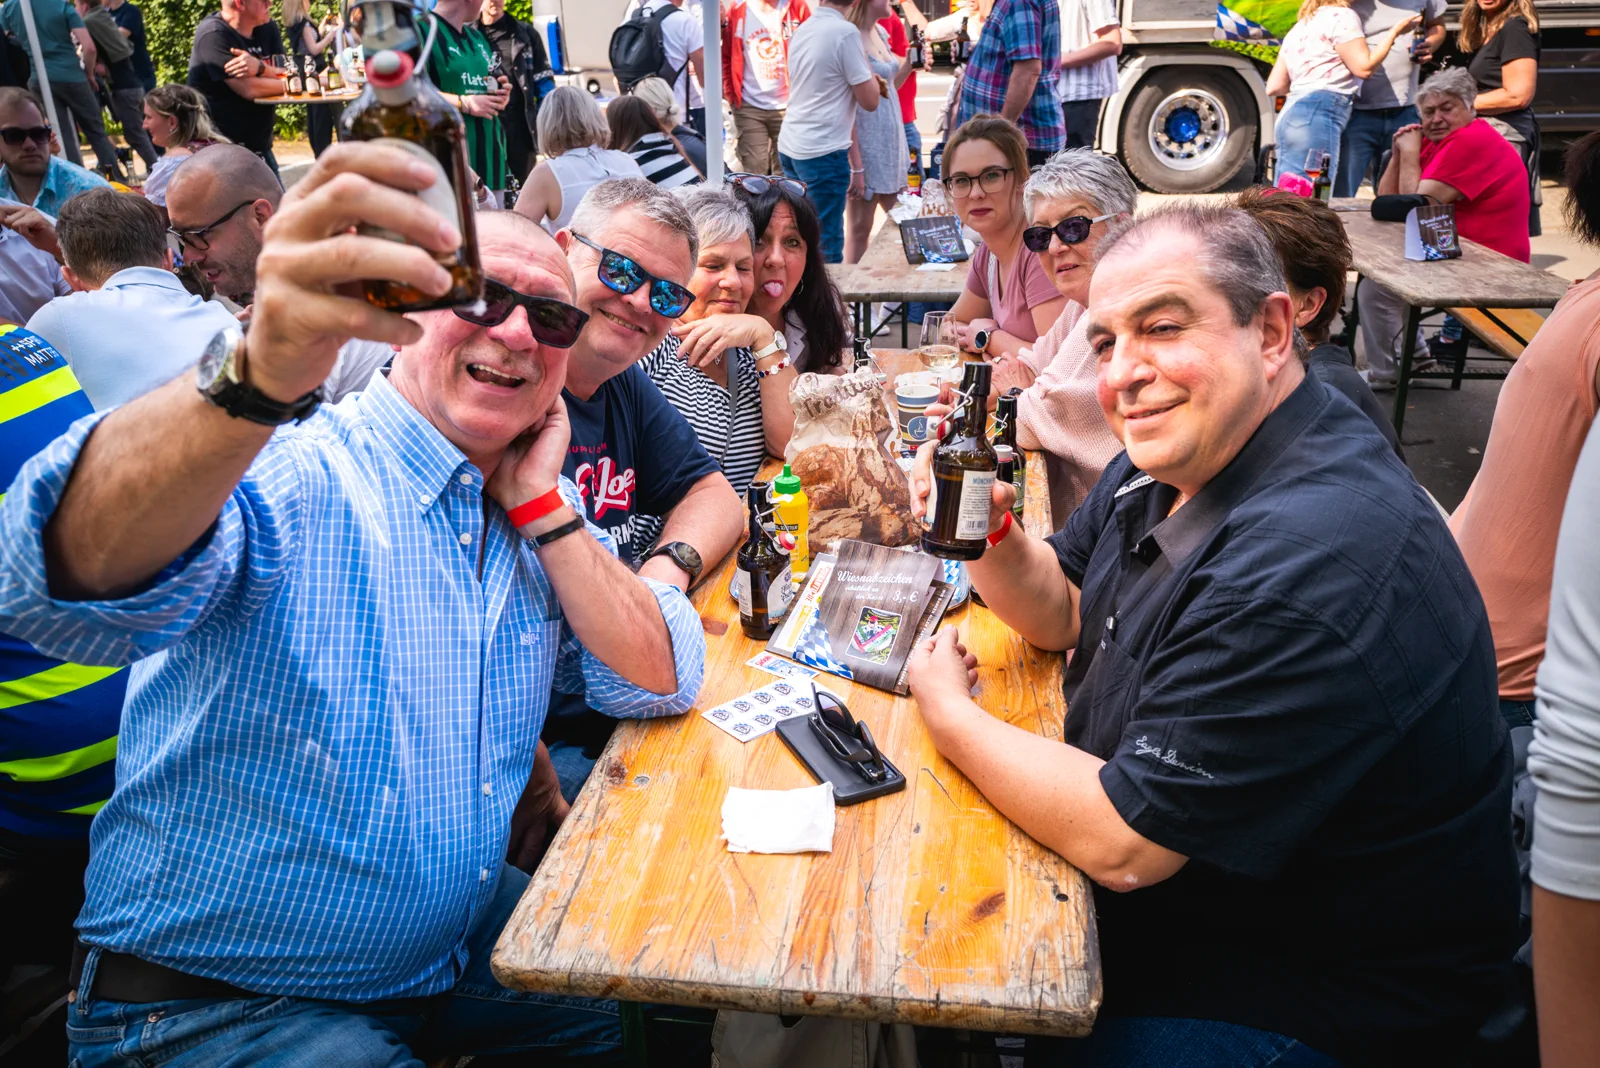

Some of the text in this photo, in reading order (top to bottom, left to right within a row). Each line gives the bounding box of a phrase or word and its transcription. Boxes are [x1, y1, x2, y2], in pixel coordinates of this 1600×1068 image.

[837, 570, 914, 584] Wiesnabzeichen
[1136, 736, 1214, 778] Eagle Denim
